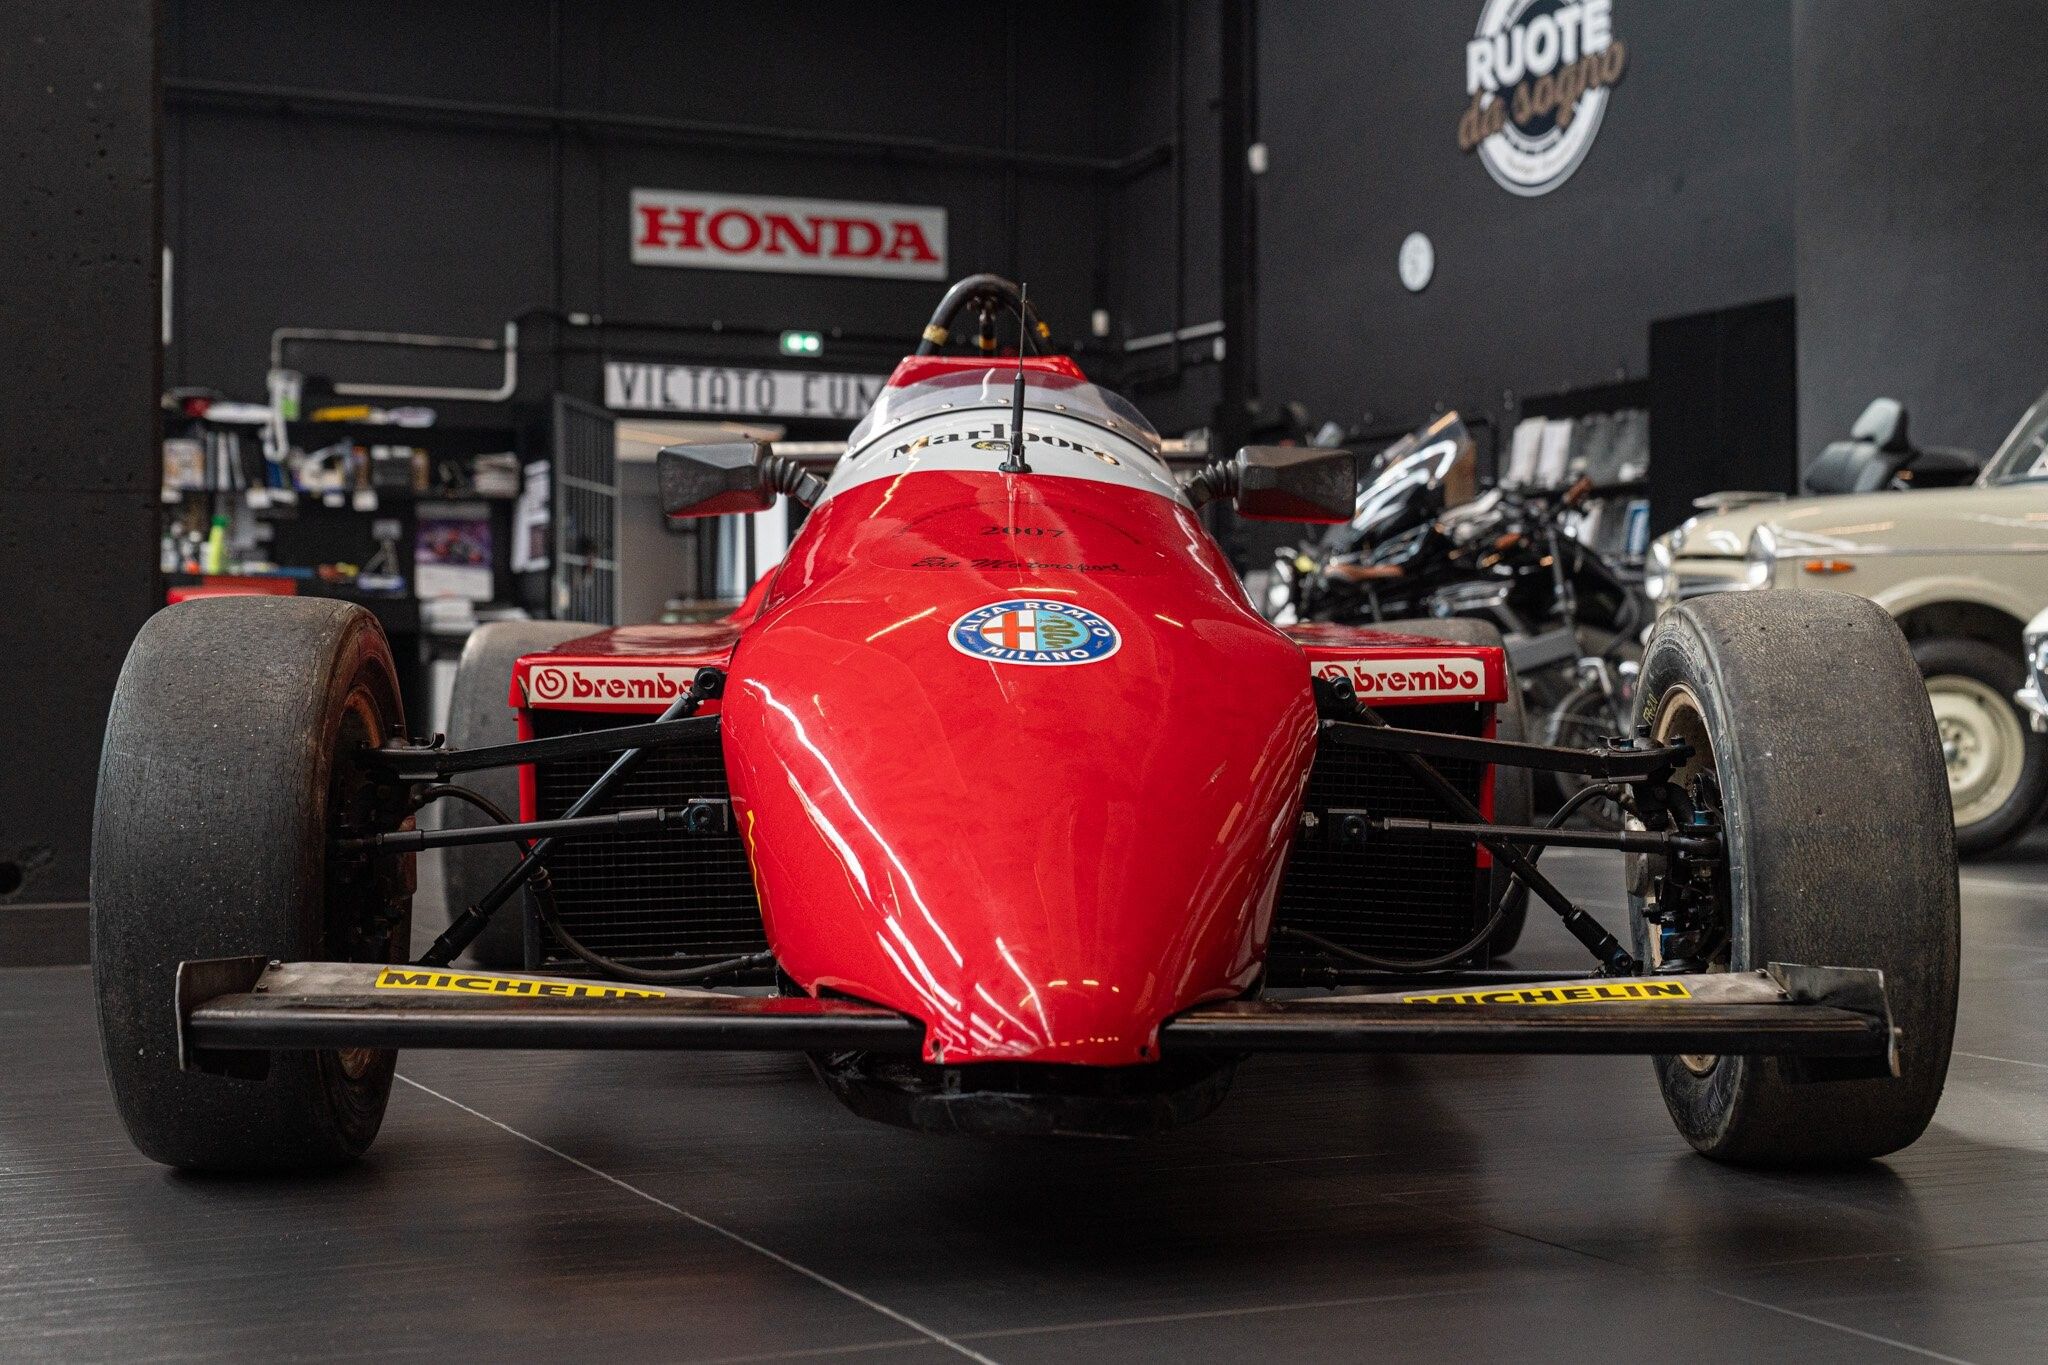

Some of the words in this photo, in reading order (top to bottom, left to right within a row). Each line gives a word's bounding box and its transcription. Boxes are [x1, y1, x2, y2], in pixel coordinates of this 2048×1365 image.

[1466, 0, 1612, 96] RUOTE
[638, 205, 940, 263] HONDA
[616, 363, 777, 414] VIETATO
[981, 526, 1065, 539] 2007
[982, 646, 1090, 661] MILANO
[1353, 664, 1479, 692] brembo
